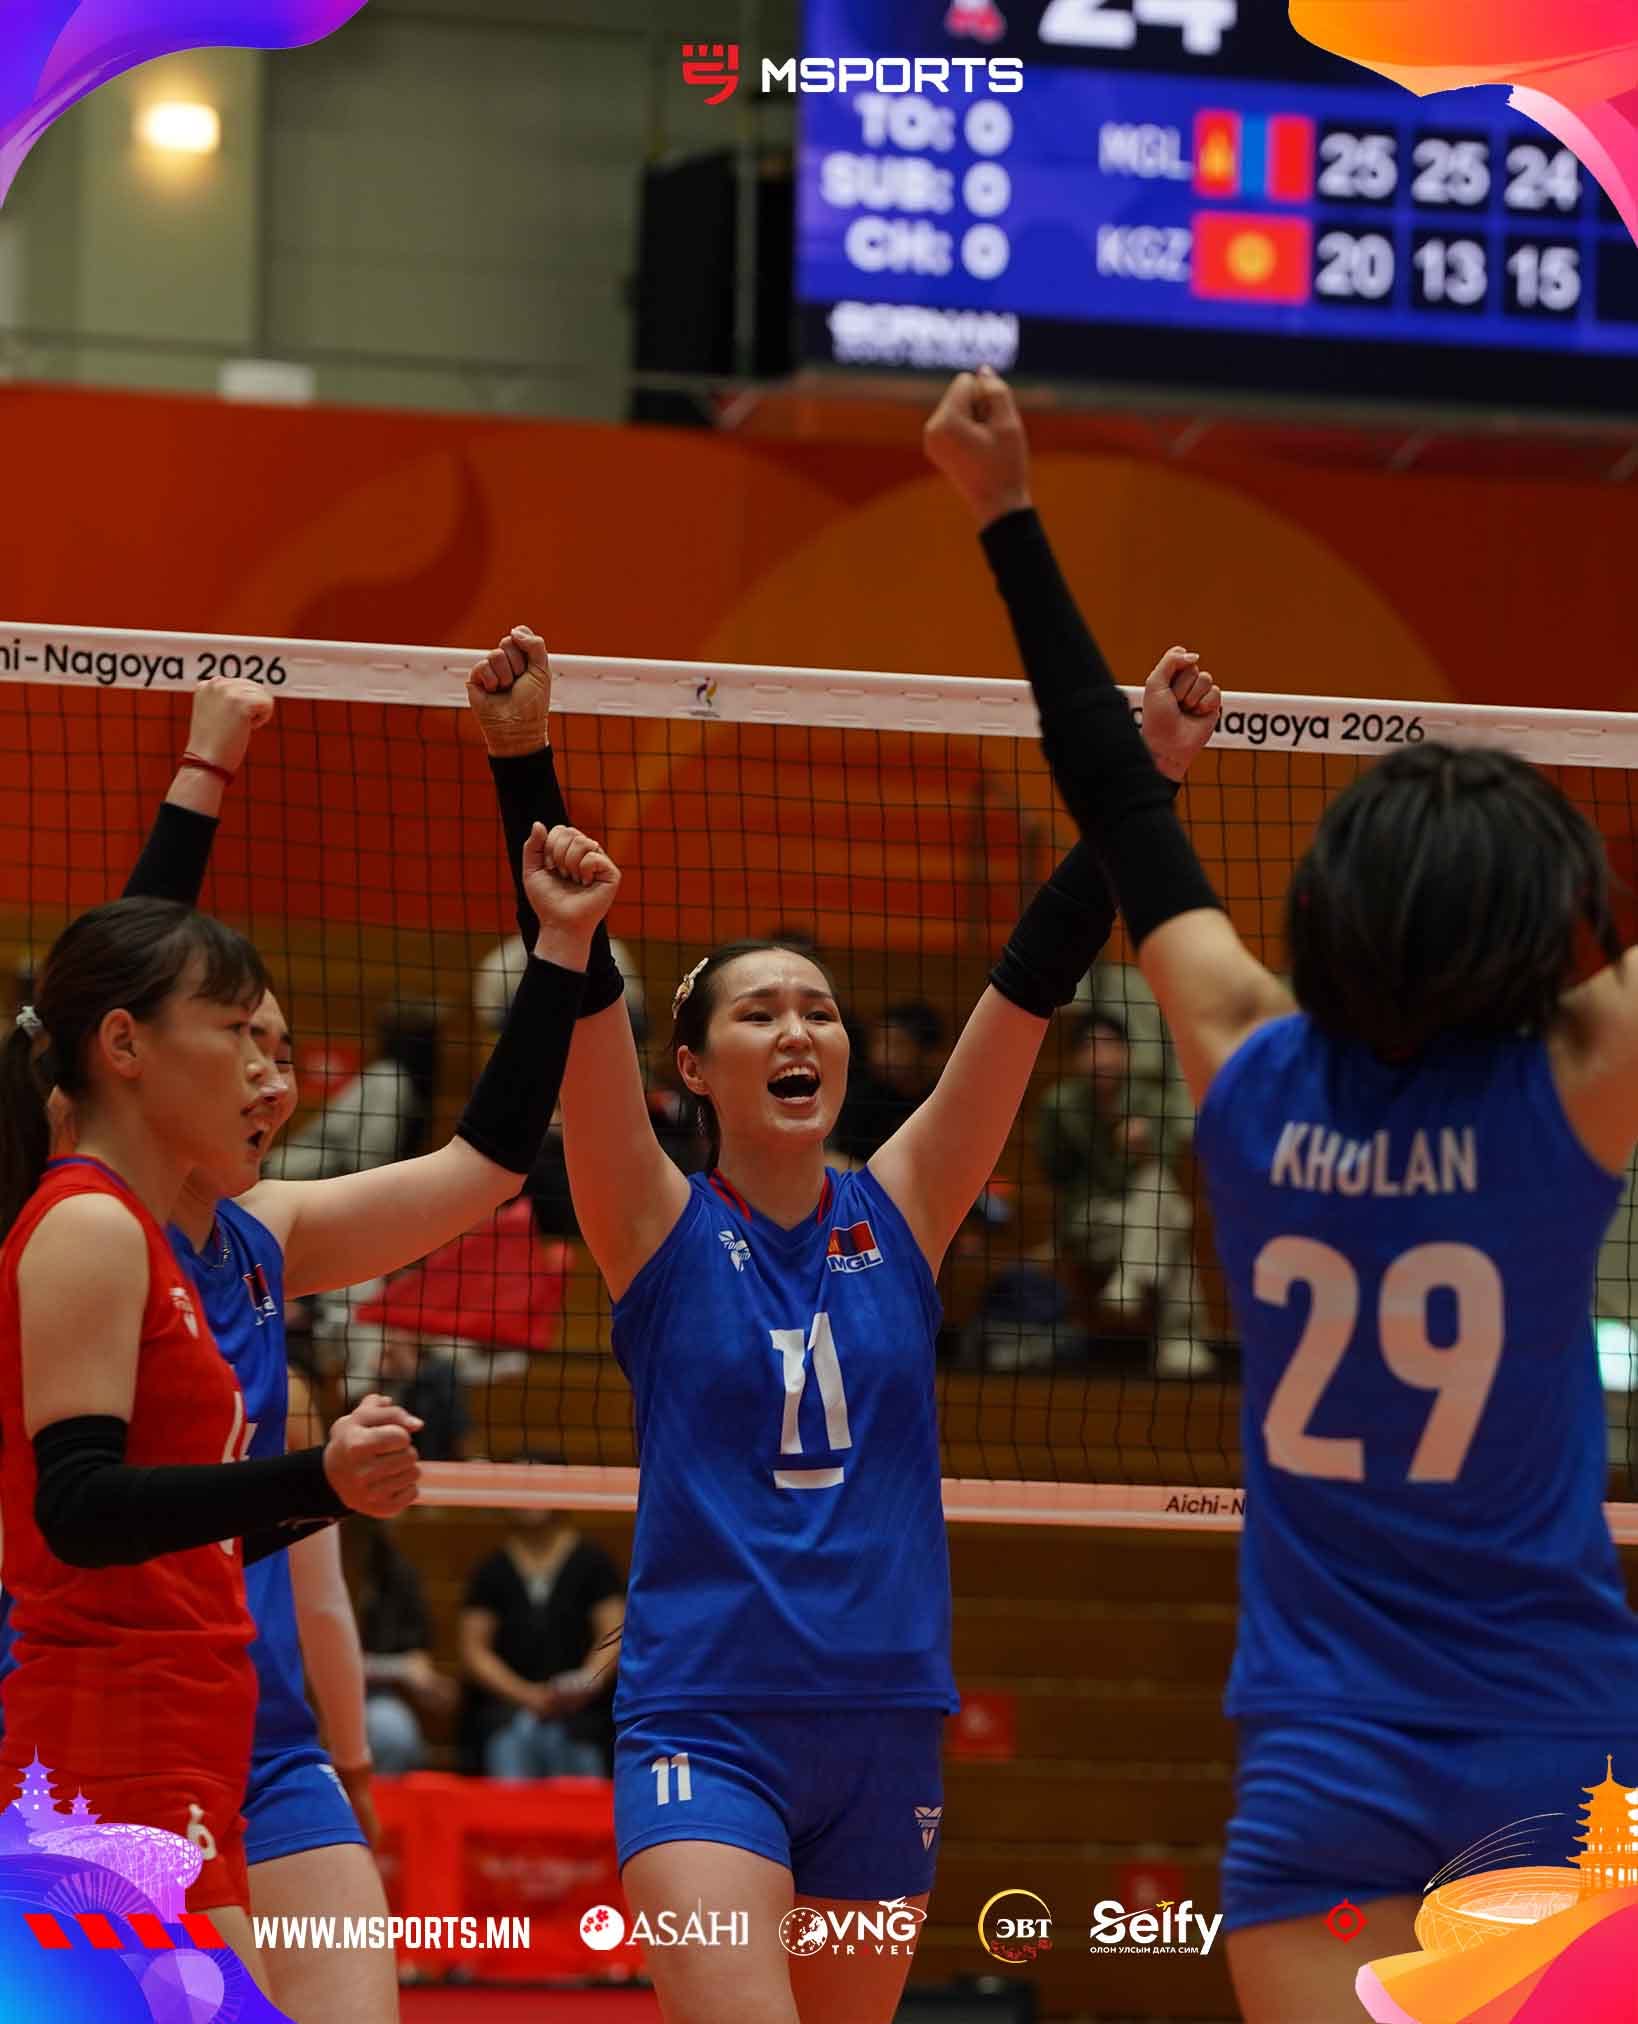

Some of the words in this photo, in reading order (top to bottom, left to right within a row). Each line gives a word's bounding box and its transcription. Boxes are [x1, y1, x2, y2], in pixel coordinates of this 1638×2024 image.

[1319, 133, 1398, 199] 25
[1412, 139, 1490, 205] 25
[1505, 145, 1580, 210] 24
[1316, 232, 1395, 298] 20
[1414, 241, 1488, 304] 13
[1508, 247, 1581, 310] 15
[197, 653, 286, 685] 2026
[1215, 706, 1329, 746] agoya
[1341, 712, 1425, 743] 2026
[828, 1252, 881, 1270] MGL
[769, 1312, 852, 1454] 11
[1253, 1234, 1505, 1483] 29
[651, 1752, 692, 1806] 11
